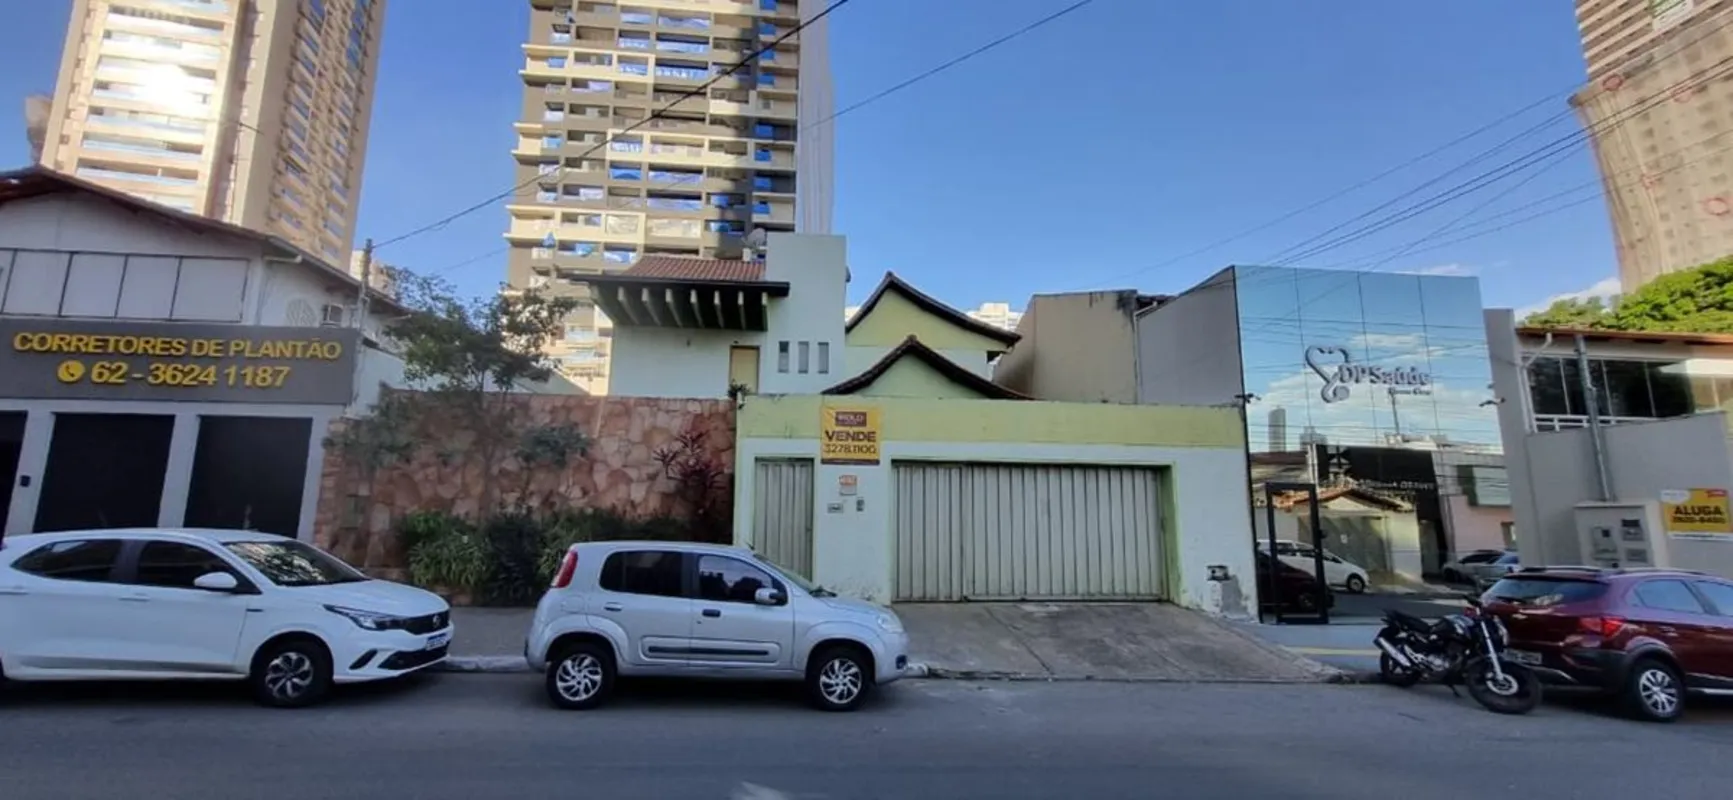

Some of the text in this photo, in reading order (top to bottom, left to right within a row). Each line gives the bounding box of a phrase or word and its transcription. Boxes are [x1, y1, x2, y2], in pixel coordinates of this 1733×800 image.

[13, 332, 343, 360] CORRETORES DE PLANTÃO
[91, 360, 129, 384] 62
[147, 363, 218, 387] 3624
[224, 365, 291, 388] 1187
[825, 431, 876, 442] VENDE
[1675, 505, 1722, 515] ALUGA
